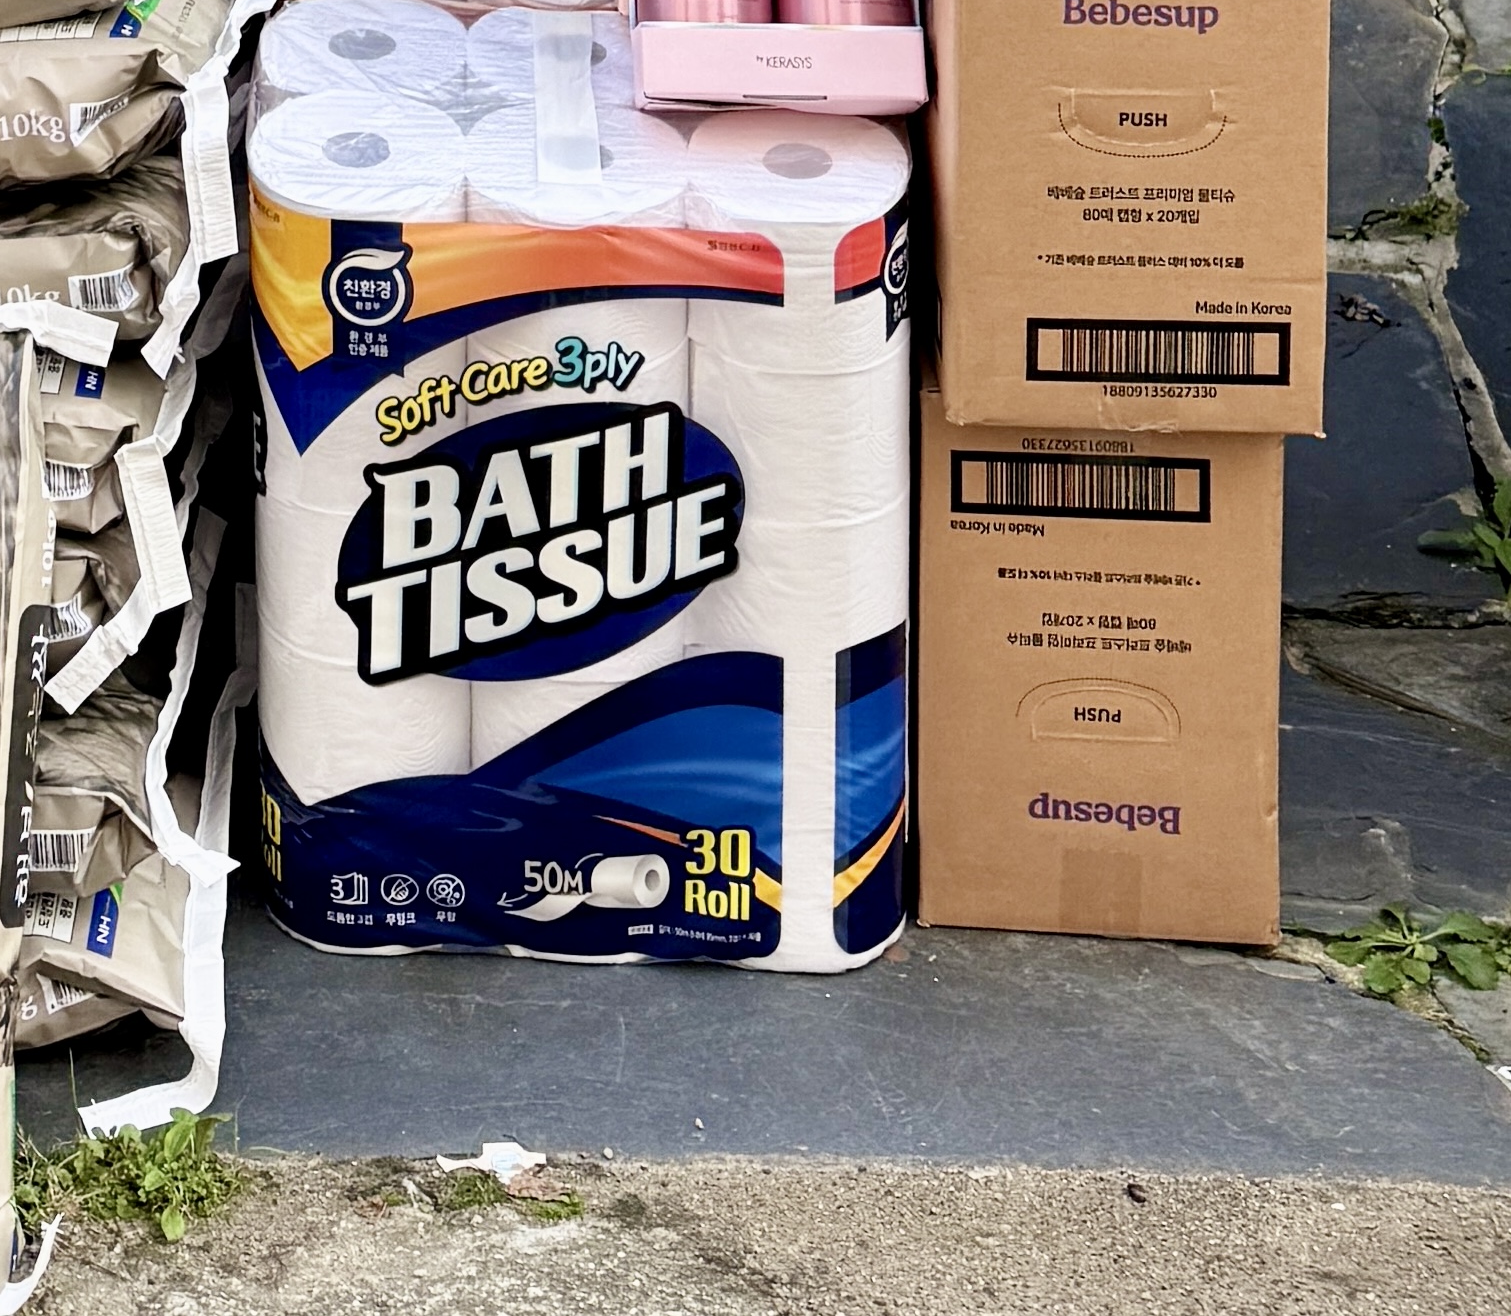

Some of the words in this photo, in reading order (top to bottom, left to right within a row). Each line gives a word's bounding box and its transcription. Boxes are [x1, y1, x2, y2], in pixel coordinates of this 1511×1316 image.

[766, 56, 813, 70] KERASYS
[0, 111, 66, 143] 10kg
[1118, 111, 1168, 127] PUSH
[1089, 186, 1139, 202] 트러스트
[1143, 187, 1195, 203] 프리미엄
[1198, 188, 1236, 203] 물티슈
[1156, 209, 1200, 224] 20개입
[1189, 257, 1211, 268] 10%
[343, 278, 391, 299] 친환경
[1195, 301, 1233, 315] Made
[1251, 301, 1292, 316] Korea
[376, 376, 456, 445] Soft
[460, 355, 549, 404] Care
[554, 336, 645, 391] 3ply
[1102, 385, 1217, 399] 18809135627330
[1021, 437, 1136, 453] 18809135627330
[372, 411, 671, 570] BATH
[950, 519, 991, 535] Korea
[1008, 522, 1045, 537] Made
[347, 482, 727, 676] TISSUE
[1074, 706, 1122, 724] PUSH
[1029, 792, 1182, 835] Bebesup
[686, 829, 751, 878] 30
[524, 860, 584, 895] 50M
[684, 879, 750, 921] Roll
[96, 916, 113, 945] NH
